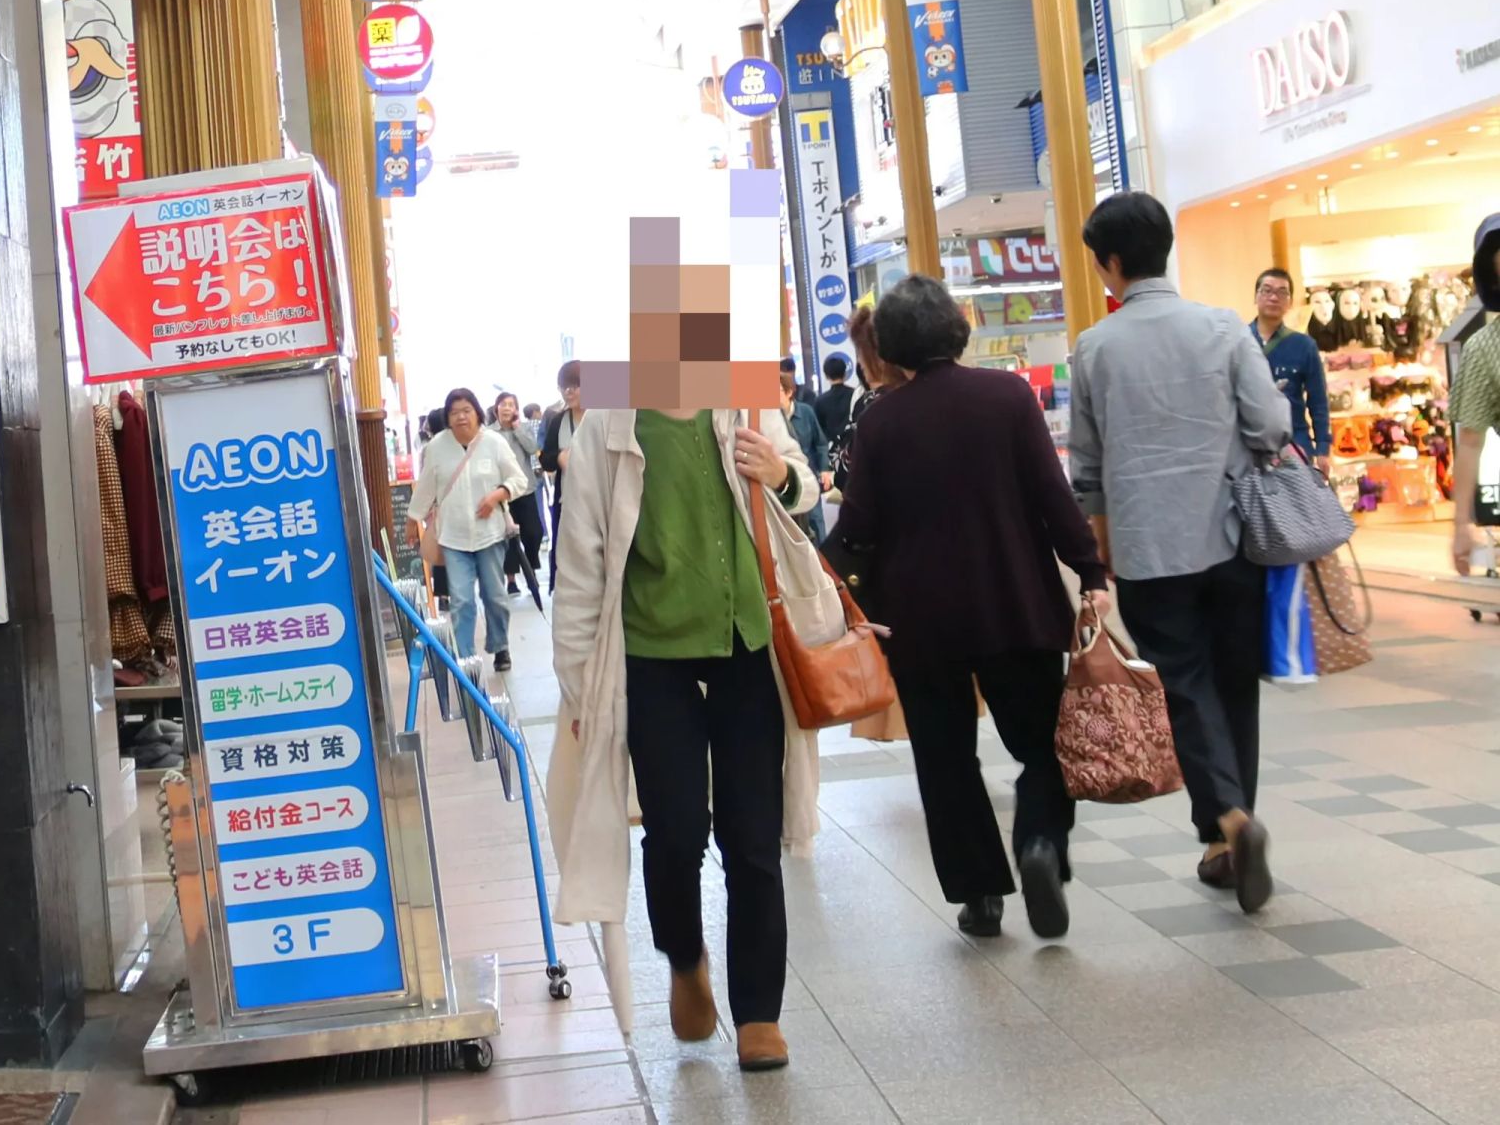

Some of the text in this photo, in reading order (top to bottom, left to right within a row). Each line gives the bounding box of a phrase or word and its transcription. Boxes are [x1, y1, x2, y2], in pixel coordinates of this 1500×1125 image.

[1251, 10, 1350, 117] DAISO
[731, 93, 777, 106] TSUTAYA
[158, 187, 305, 221] AEON 英会話イーオン
[811, 160, 837, 269] Tポイントが
[139, 217, 307, 274] 説明会は
[184, 431, 324, 486] AEON
[202, 501, 319, 547] 英会話
[194, 547, 338, 595] イーオン
[204, 612, 332, 653] 日常英会話
[208, 673, 338, 715] 留学・ホームステイ
[220, 734, 348, 774] 資格対策
[226, 792, 356, 835] 給付金コース
[231, 855, 366, 895] こども英会話
[272, 917, 334, 957] 3F
